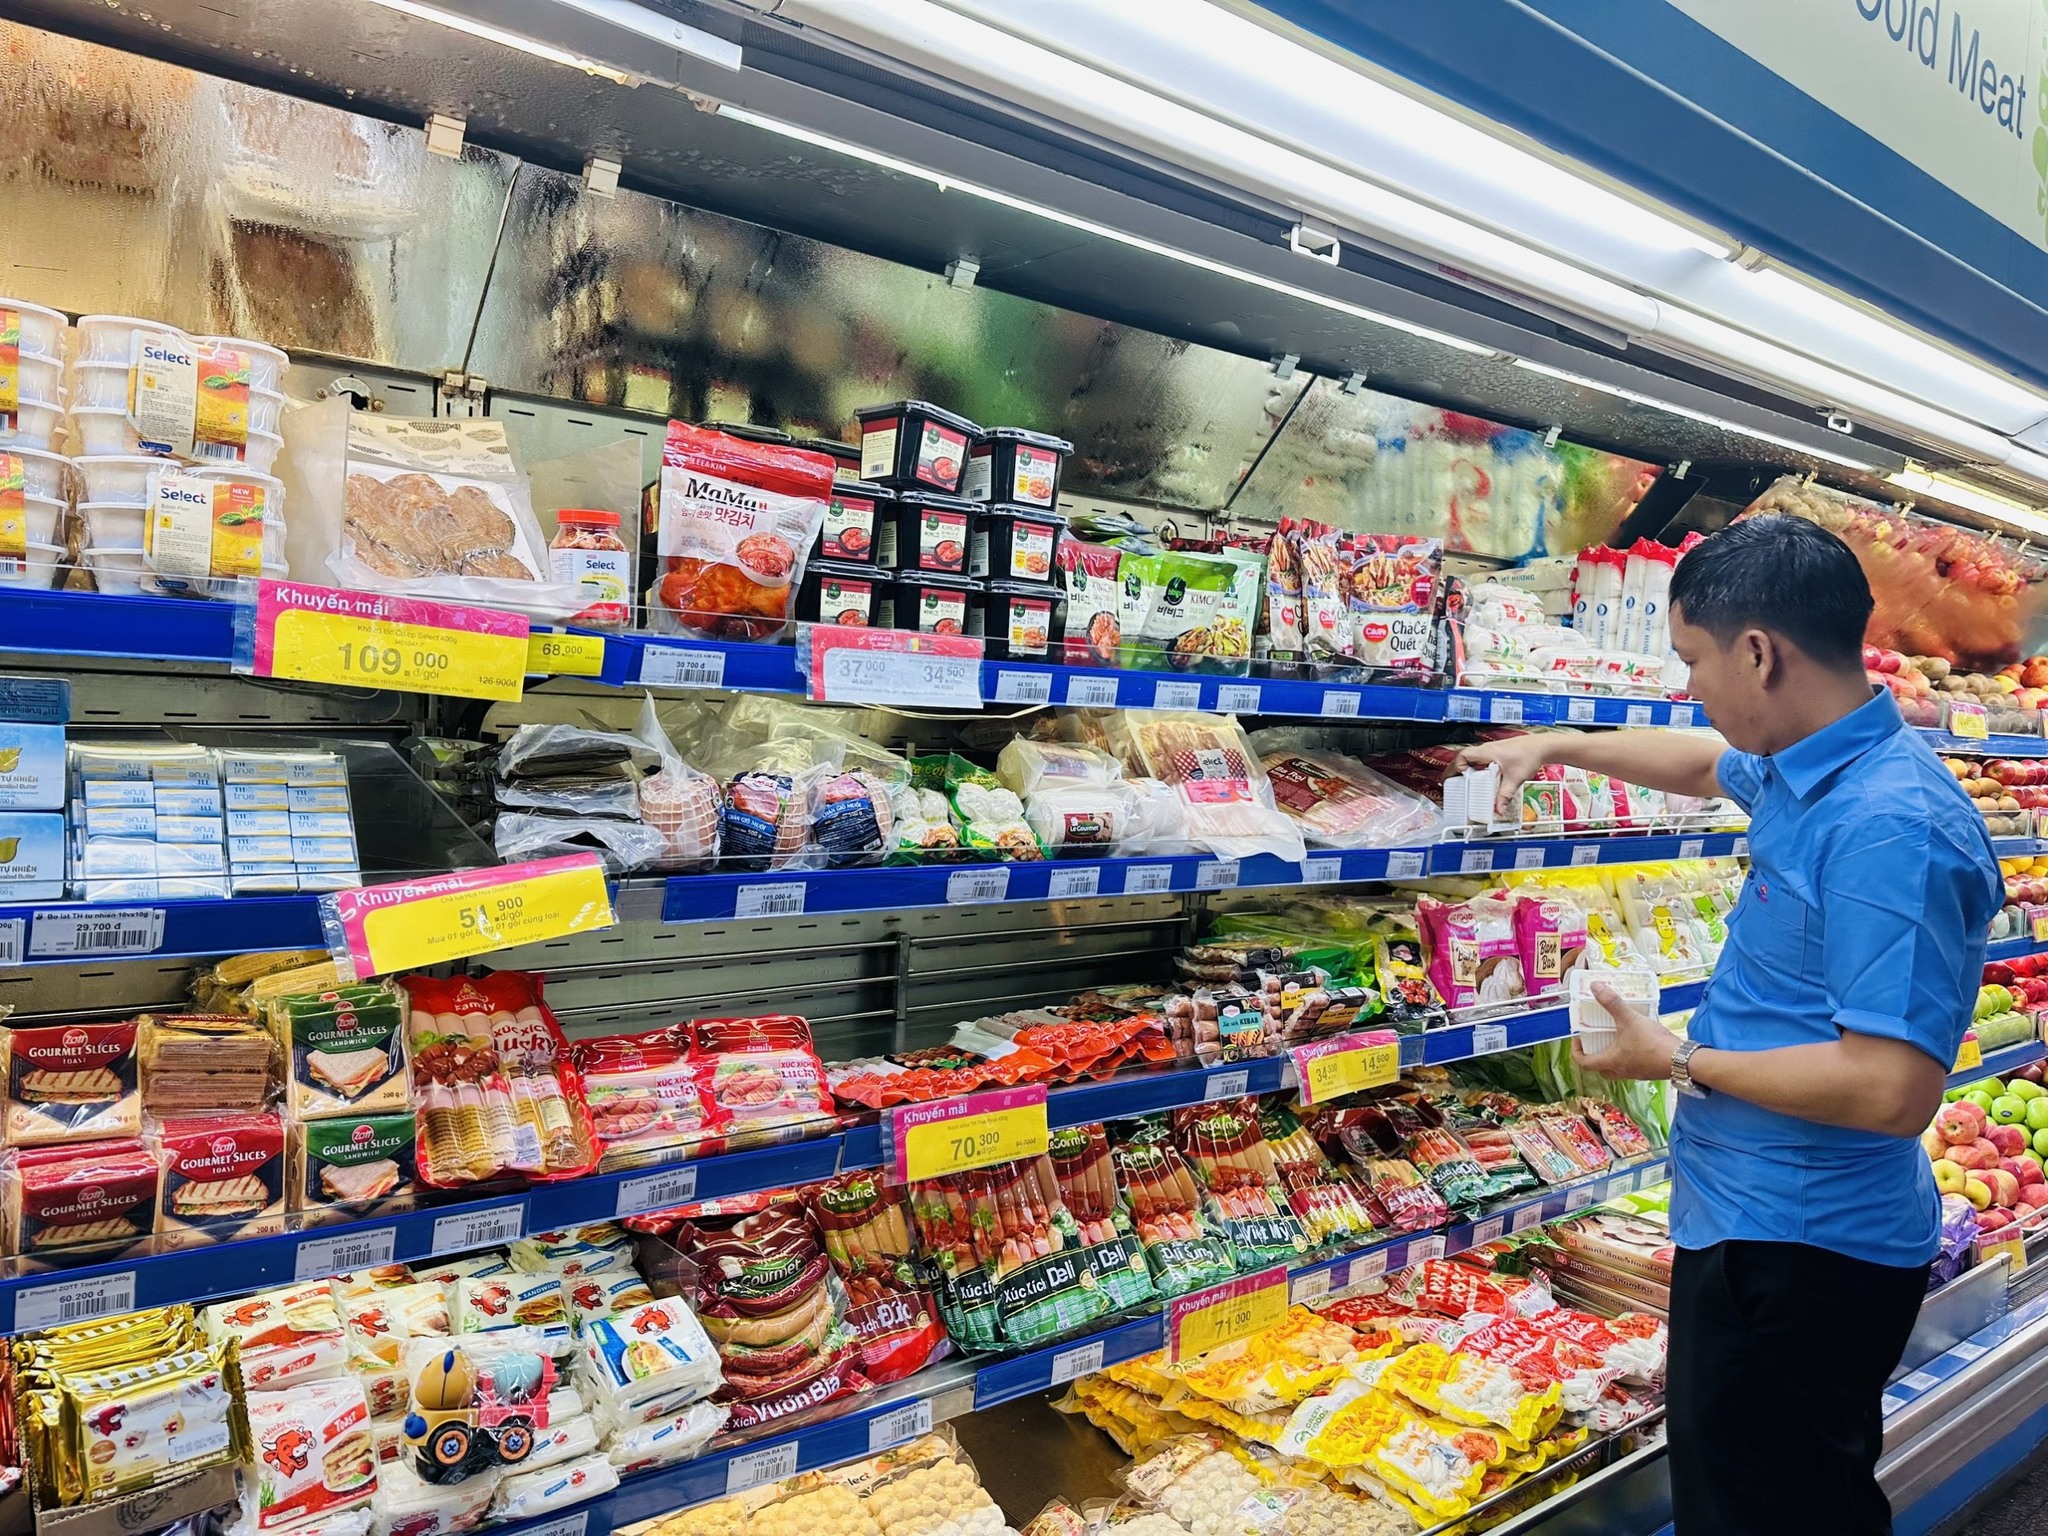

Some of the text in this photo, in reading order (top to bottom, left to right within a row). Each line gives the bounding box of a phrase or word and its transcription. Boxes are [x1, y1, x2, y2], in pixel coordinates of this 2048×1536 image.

[1948, 11, 2026, 139] Meat
[144, 346, 191, 366] Select
[161, 487, 207, 505] Select
[232, 487, 250, 496] NEW
[685, 477, 757, 512] MaMa
[714, 507, 756, 530] 맛김치
[586, 559, 615, 570] Select
[276, 587, 390, 616] Khuyến mãi
[1157, 605, 1184, 618] 비비고
[413, 651, 449, 669] 000
[234, 766, 254, 774] true
[293, 770, 314, 778] true
[234, 792, 254, 800] true
[296, 795, 316, 803] true
[235, 818, 256, 826] true
[298, 820, 319, 828] true
[237, 844, 258, 852] true
[301, 846, 320, 854] true
[497, 896, 523, 911] 900
[76, 922, 121, 931] 29.700 đ
[427, 936, 445, 945] Mua
[460, 928, 474, 940] gói
[496, 922, 506, 930] 01
[508, 918, 521, 929] gói
[524, 915, 543, 926] cùng
[454, 1001, 496, 1012] Family
[1240, 1017, 1259, 1025] KEBAB
[308, 1025, 387, 1041] GOURMET SLICES
[494, 1025, 519, 1038] XÚC
[330, 1037, 368, 1047] SANDWICH
[747, 1044, 773, 1053] Family
[28, 1043, 121, 1059] GOURMET SLICES
[62, 1057, 87, 1065] TOAST
[618, 1060, 648, 1072] Family
[656, 1077, 673, 1087] XÚC
[383, 1091, 395, 1099] 200
[656, 1082, 699, 1100] Lucky
[903, 1103, 968, 1124] Khuyến mãi
[979, 1131, 1000, 1146] 300
[322, 1136, 401, 1157] GOURMET SLICES
[180, 1150, 267, 1170] GOURMET SLICES
[344, 1150, 380, 1160] SANDWICH
[212, 1165, 235, 1174] TOAST
[41, 1195, 138, 1217] GOURMET SLICES
[77, 1209, 102, 1218] TOAST
[257, 1225, 270, 1234] 200
[466, 1220, 492, 1230] 76.200
[333, 1244, 362, 1255] 60.200
[1098, 1243, 1127, 1267] Deli
[740, 1259, 802, 1288] Gourmet
[58, 1283, 79, 1291] ZOTT
[80, 1280, 100, 1288] Toast
[612, 1278, 642, 1292] SANDWICH
[1003, 1262, 1076, 1304] Xúc Deli
[59, 1289, 105, 1303] 60.200 đ
[296, 1289, 319, 1301] TOAST
[523, 1281, 560, 1299] SANDWICH
[1179, 1289, 1227, 1313] Khuyến mãi
[1215, 1310, 1251, 1339] 71 000
[733, 1372, 842, 1428] Xích Vườn Bia
[334, 1410, 357, 1432] TOAST
[1306, 1404, 1329, 1433] GREEN FOODS
